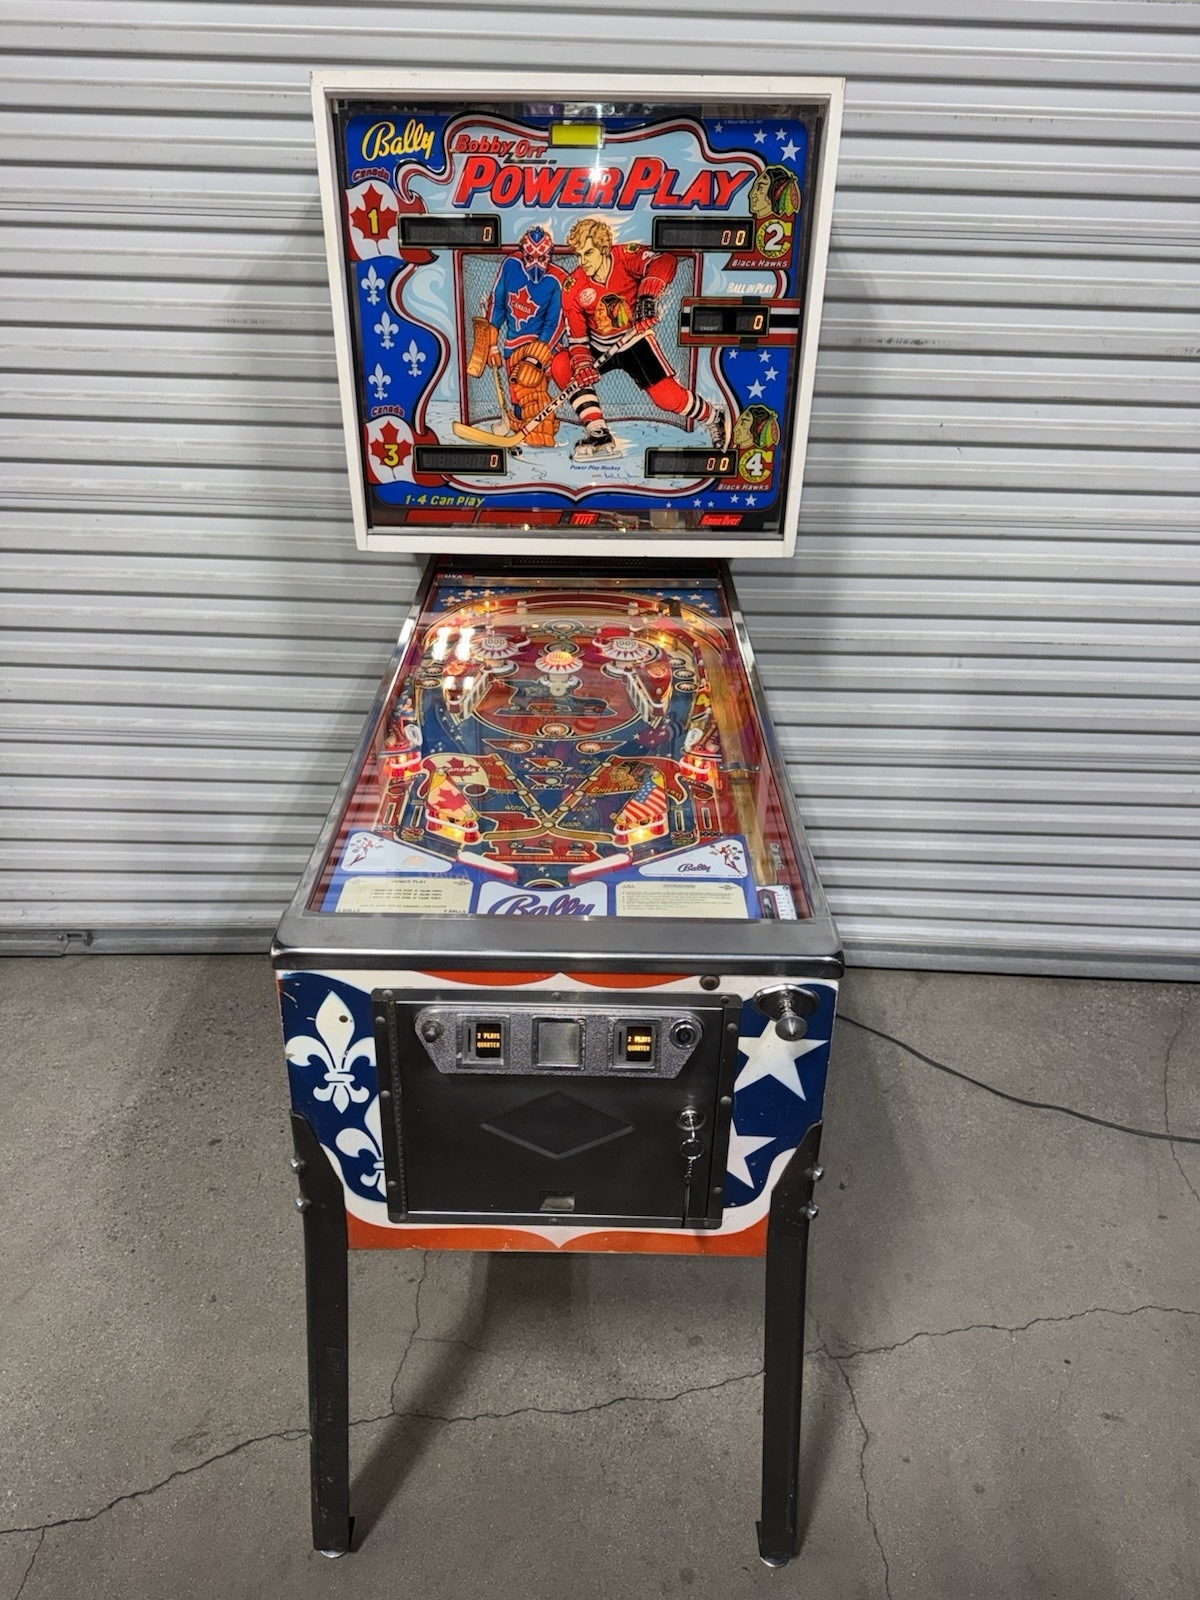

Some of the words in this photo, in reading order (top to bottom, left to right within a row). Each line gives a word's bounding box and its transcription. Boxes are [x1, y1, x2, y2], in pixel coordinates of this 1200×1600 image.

[362, 119, 434, 162] Bally
[455, 134, 516, 158] Bobby
[514, 139, 547, 158] Orr
[352, 167, 391, 183] Canada
[452, 154, 623, 209] POWER
[617, 156, 756, 210] PLAY
[368, 209, 379, 234] 1
[482, 226, 492, 241] 0
[765, 223, 784, 251] 2
[732, 259, 756, 267] Black
[757, 259, 788, 267] Hawks
[727, 281, 746, 294] BALL
[745, 283, 757, 294] IN
[756, 282, 776, 294] PLAY
[510, 301, 533, 315] CANADA
[753, 314, 764, 330] 0
[371, 405, 405, 417] Canada
[383, 444, 399, 467] 3
[489, 454, 499, 468] 0
[600, 464, 621, 472] Hockey
[745, 452, 763, 477] 4
[405, 494, 427, 505] 1-4
[430, 495, 454, 506] Can
[456, 496, 486, 508] Play
[702, 515, 722, 526] Game
[722, 515, 740, 526] Over
[677, 863, 711, 873] Bally
[487, 894, 595, 916] Bally
